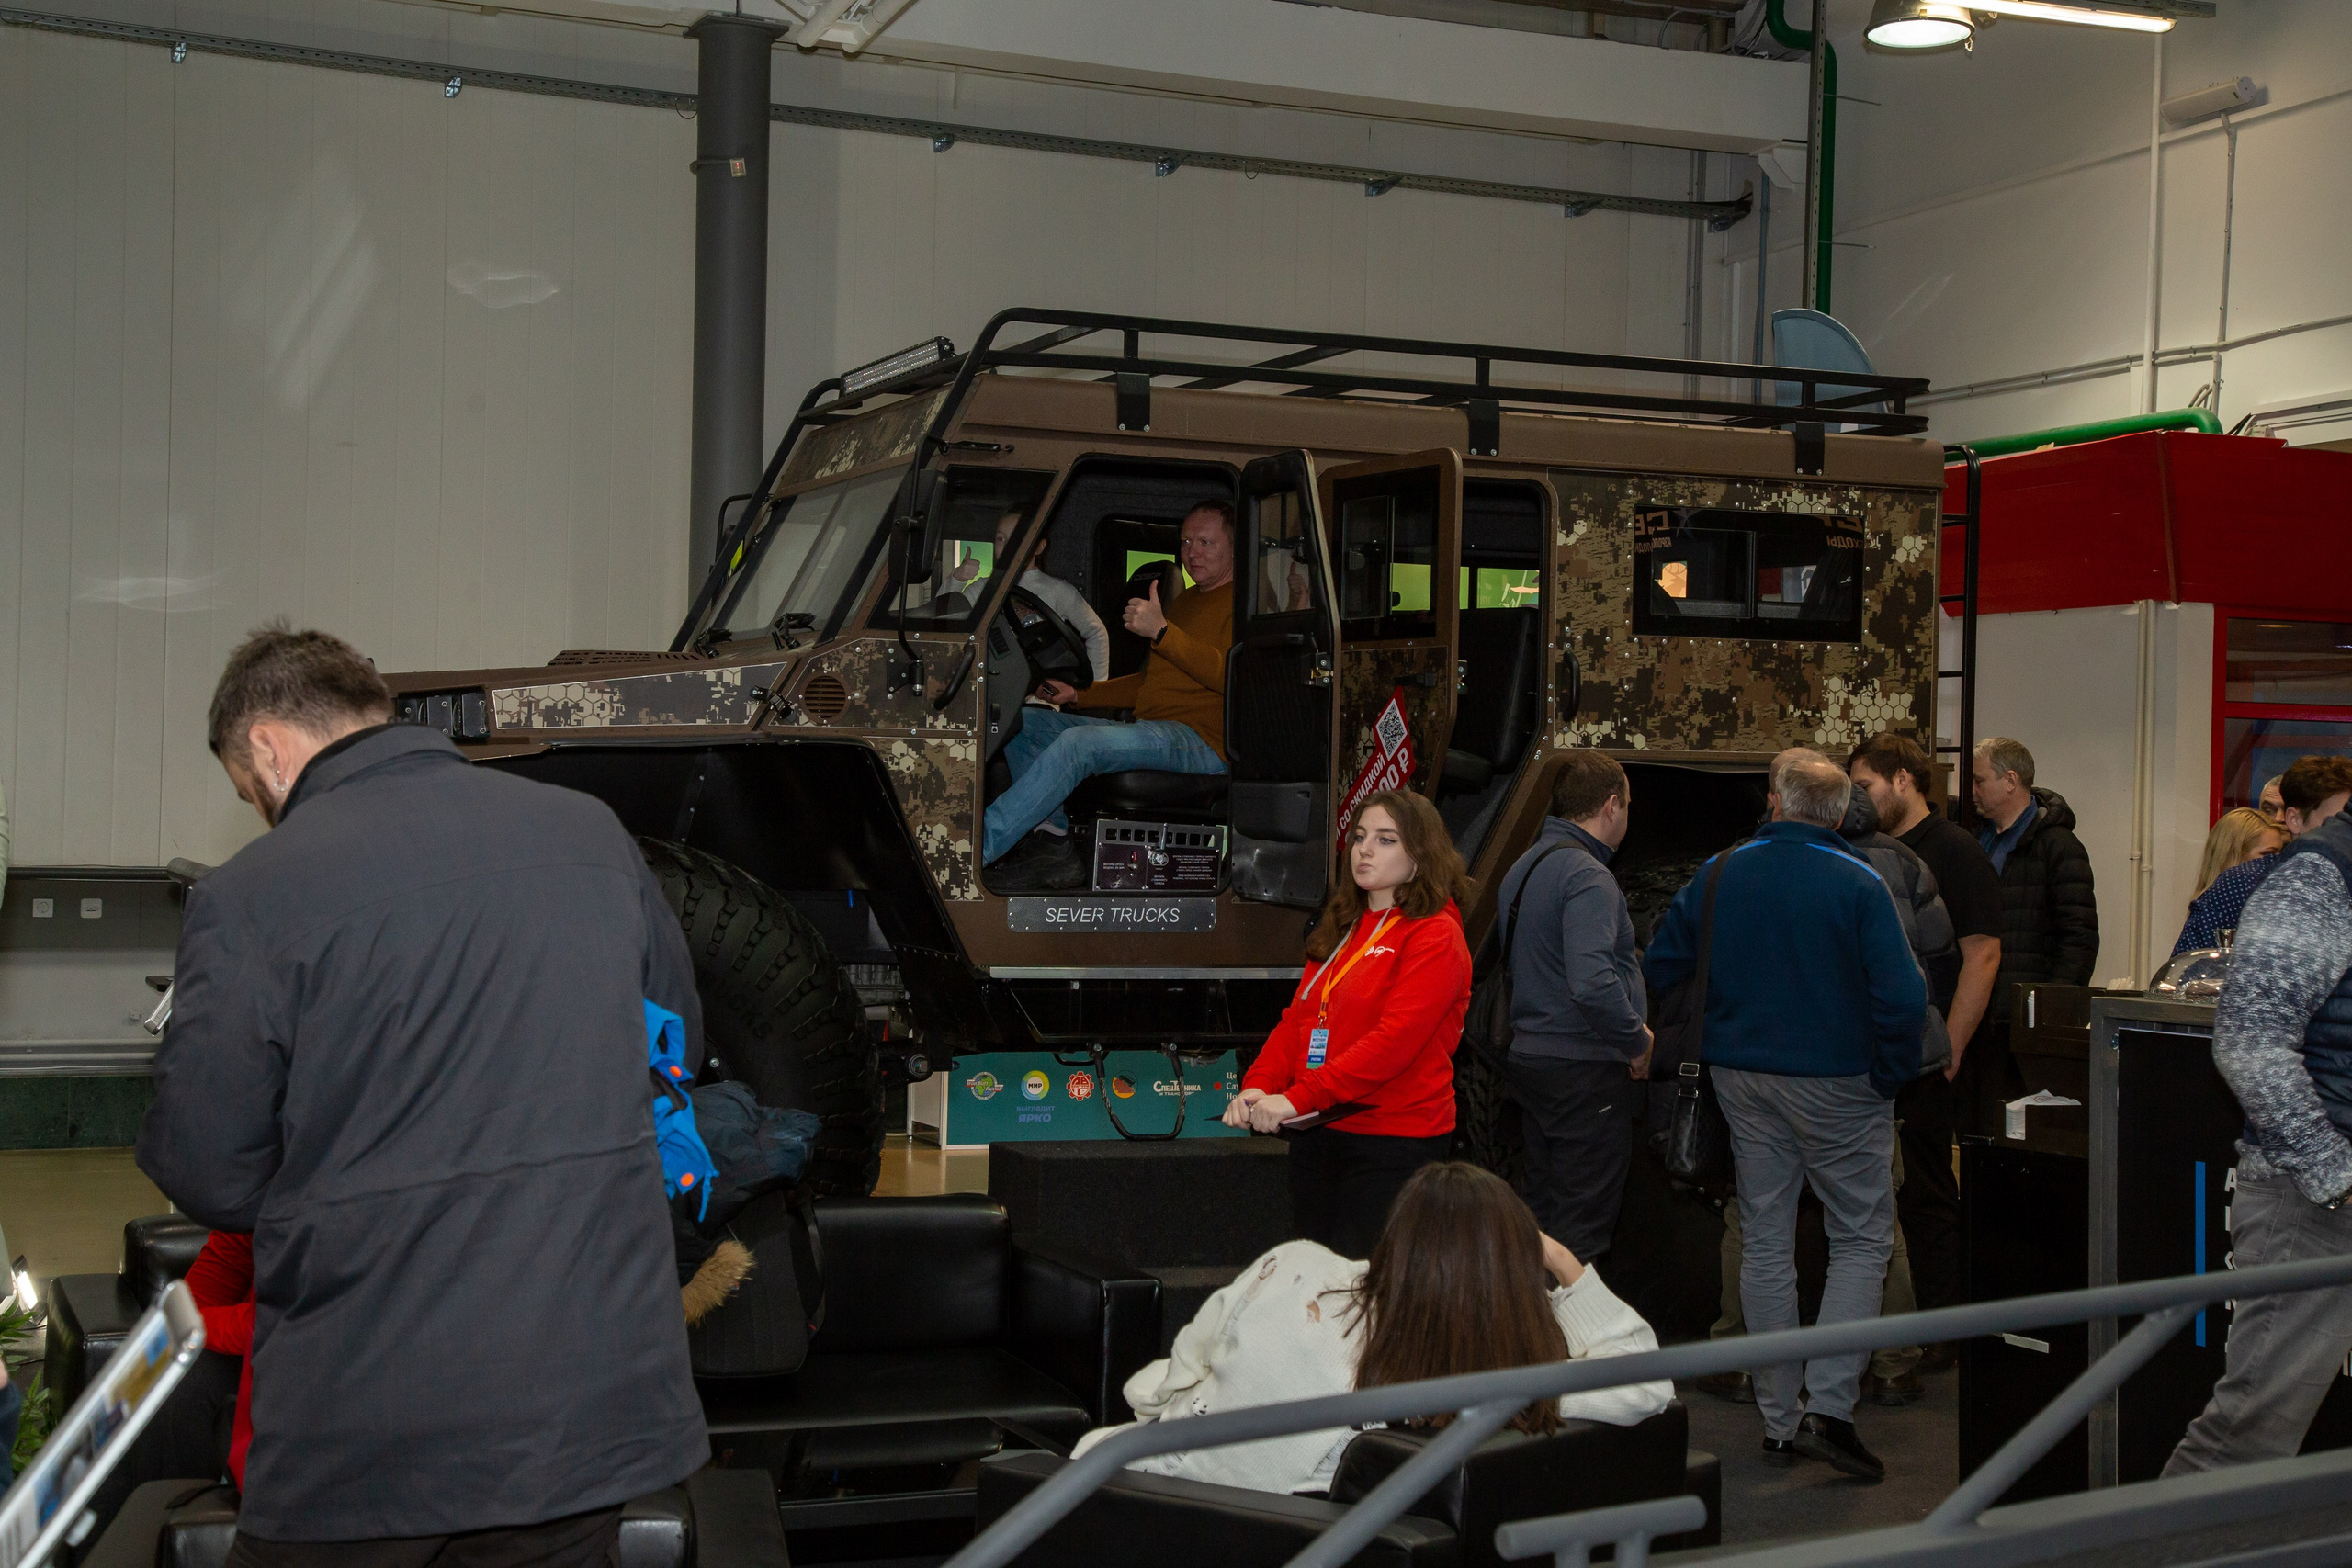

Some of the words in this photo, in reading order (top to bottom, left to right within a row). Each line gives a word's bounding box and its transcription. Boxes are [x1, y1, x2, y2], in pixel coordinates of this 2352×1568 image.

[1340, 809, 1351, 830] СО
[1350, 752, 1386, 811] СКИДКОЙ
[1045, 908, 1104, 923] SEVER
[1110, 908, 1181, 923] TRUCKS
[1227, 1072, 1238, 1080] Це
[1153, 1080, 1202, 1092] СПЕЦТЕНИКА
[1018, 1113, 1052, 1123] ЯРКО
